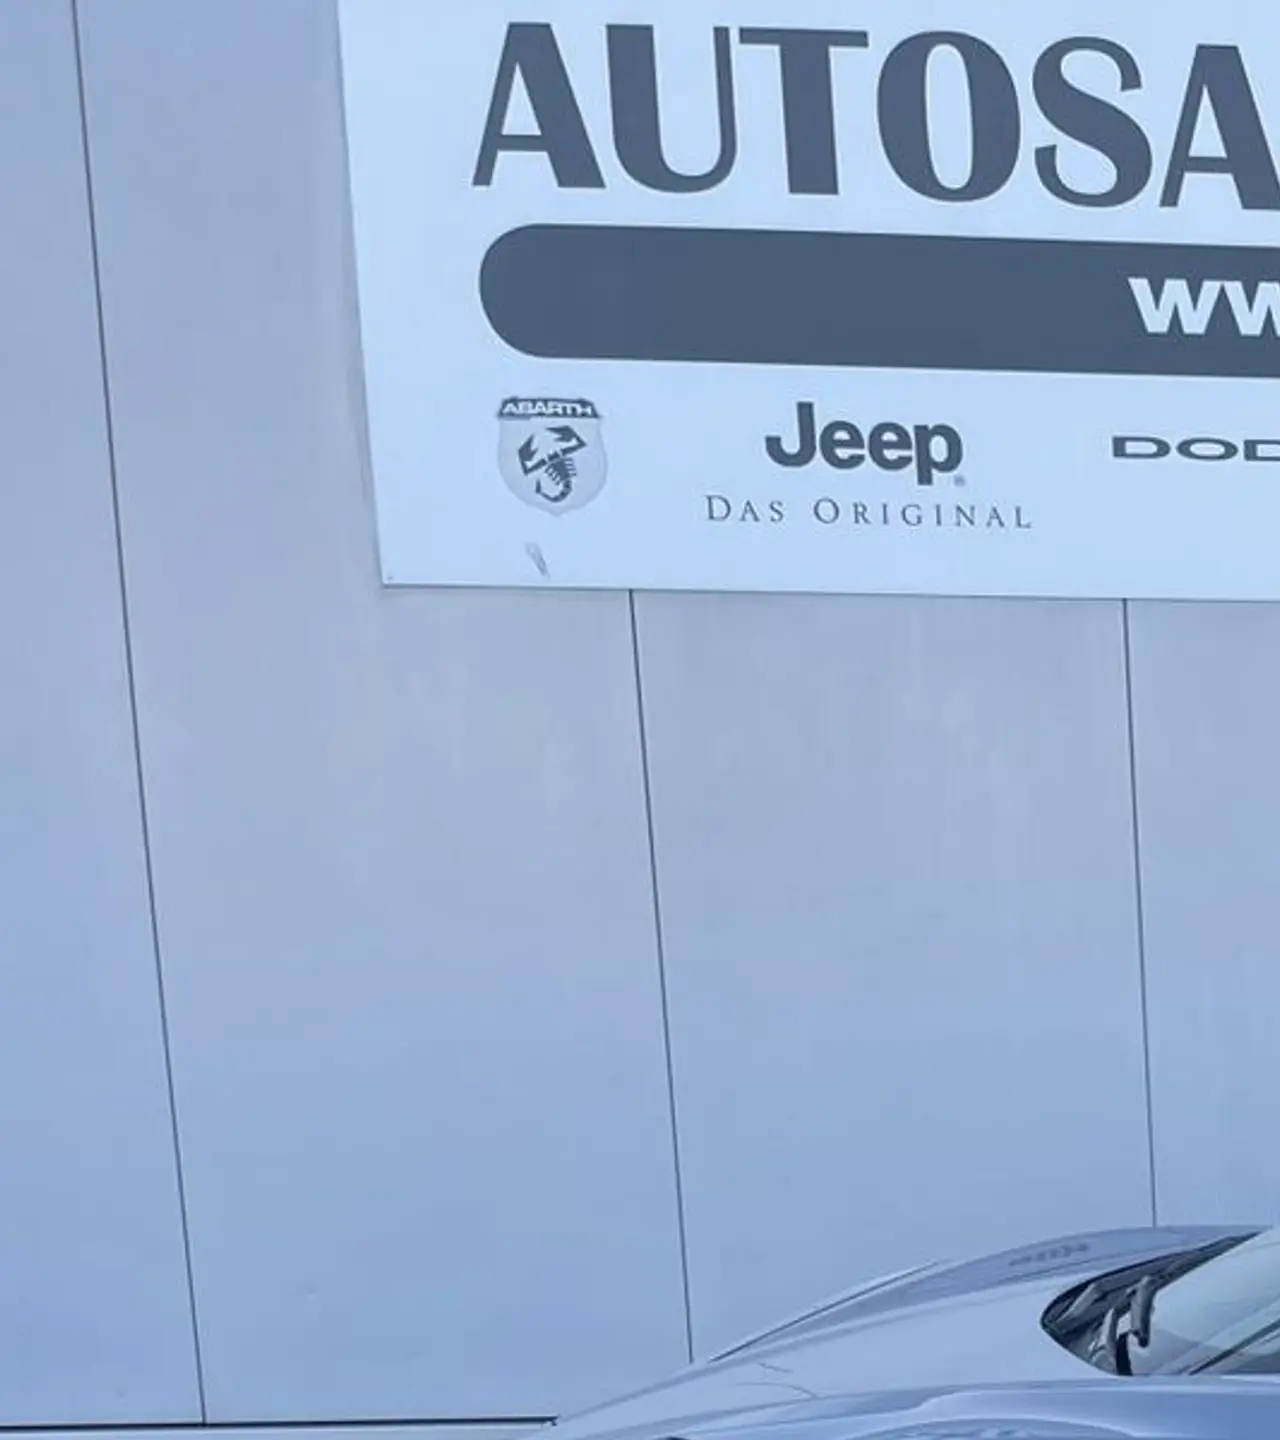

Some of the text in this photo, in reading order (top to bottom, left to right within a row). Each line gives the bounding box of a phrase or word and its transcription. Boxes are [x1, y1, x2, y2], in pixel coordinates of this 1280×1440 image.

[501, 400, 593, 416] ABARTH
[765, 400, 964, 486] Jeep
[705, 494, 1033, 530] DAS ORIGINAL
